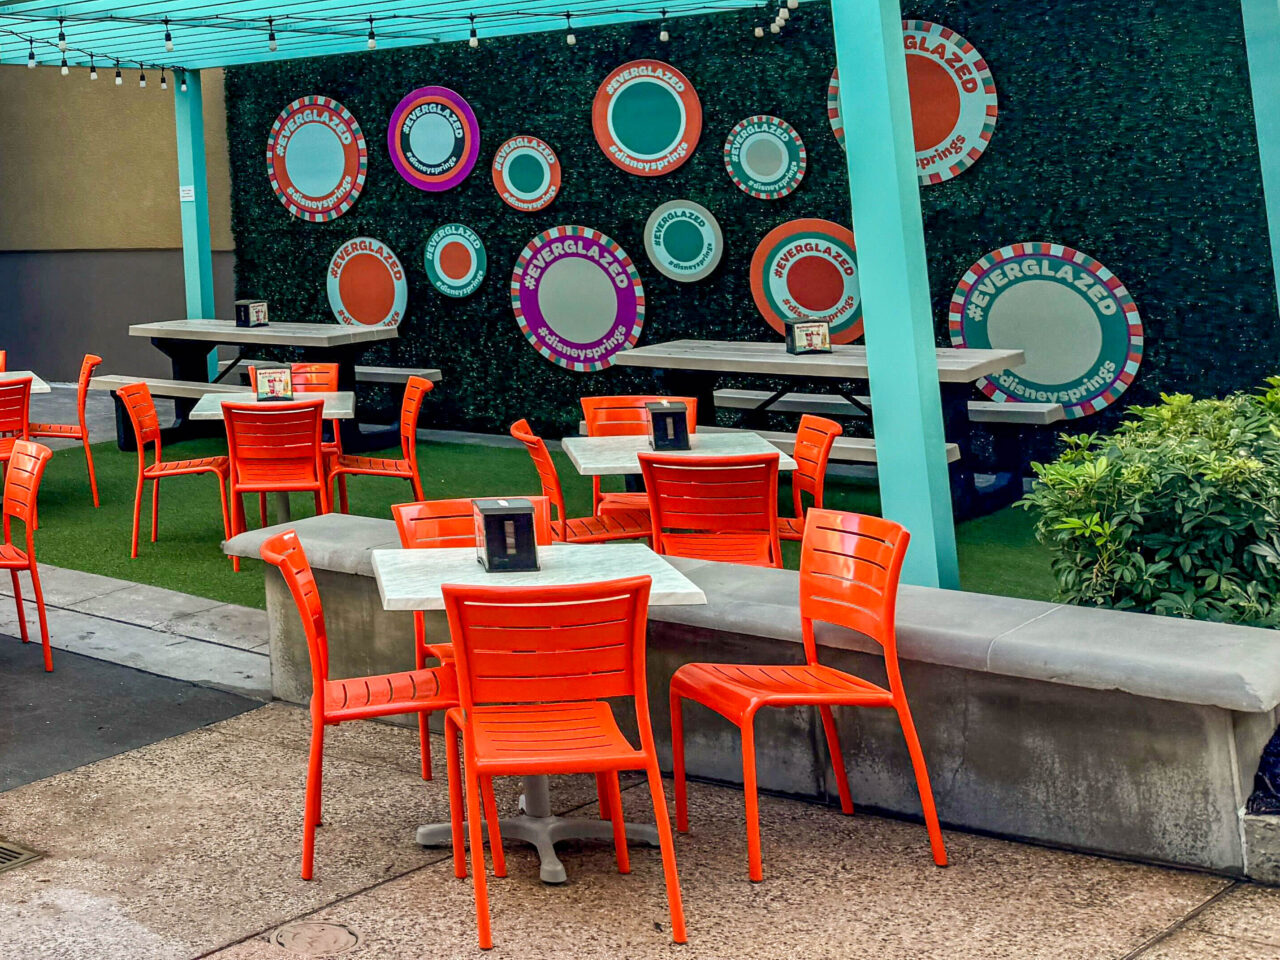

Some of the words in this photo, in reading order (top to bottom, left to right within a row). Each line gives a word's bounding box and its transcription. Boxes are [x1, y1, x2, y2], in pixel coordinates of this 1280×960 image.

[606, 66, 685, 95] #EVERGLAZED
[276, 109, 352, 157] #EVERGLAZED
[403, 103, 463, 138] #EVERGLAZED
[495, 138, 555, 171] #EVERGLAZED
[609, 142, 688, 172] #disneysprings
[731, 123, 789, 162] #EVERGLAZED
[406, 152, 457, 174] #disneysprings
[747, 161, 798, 191] #disneysprings
[287, 175, 352, 210] #disneysprings
[426, 226, 480, 260] #EVERGLAZED
[653, 210, 706, 247] #EVERGLAZED
[330, 240, 402, 281] #EVERGLAZED
[524, 240, 628, 290] #EVERGLAZED
[668, 243, 713, 271] #disneysprings
[774, 243, 855, 278] #EVERGLAZED
[436, 270, 483, 297] #disneysprings
[966, 259, 1117, 322] #EVERGLAZED
[537, 324, 627, 360] #disneysprings
